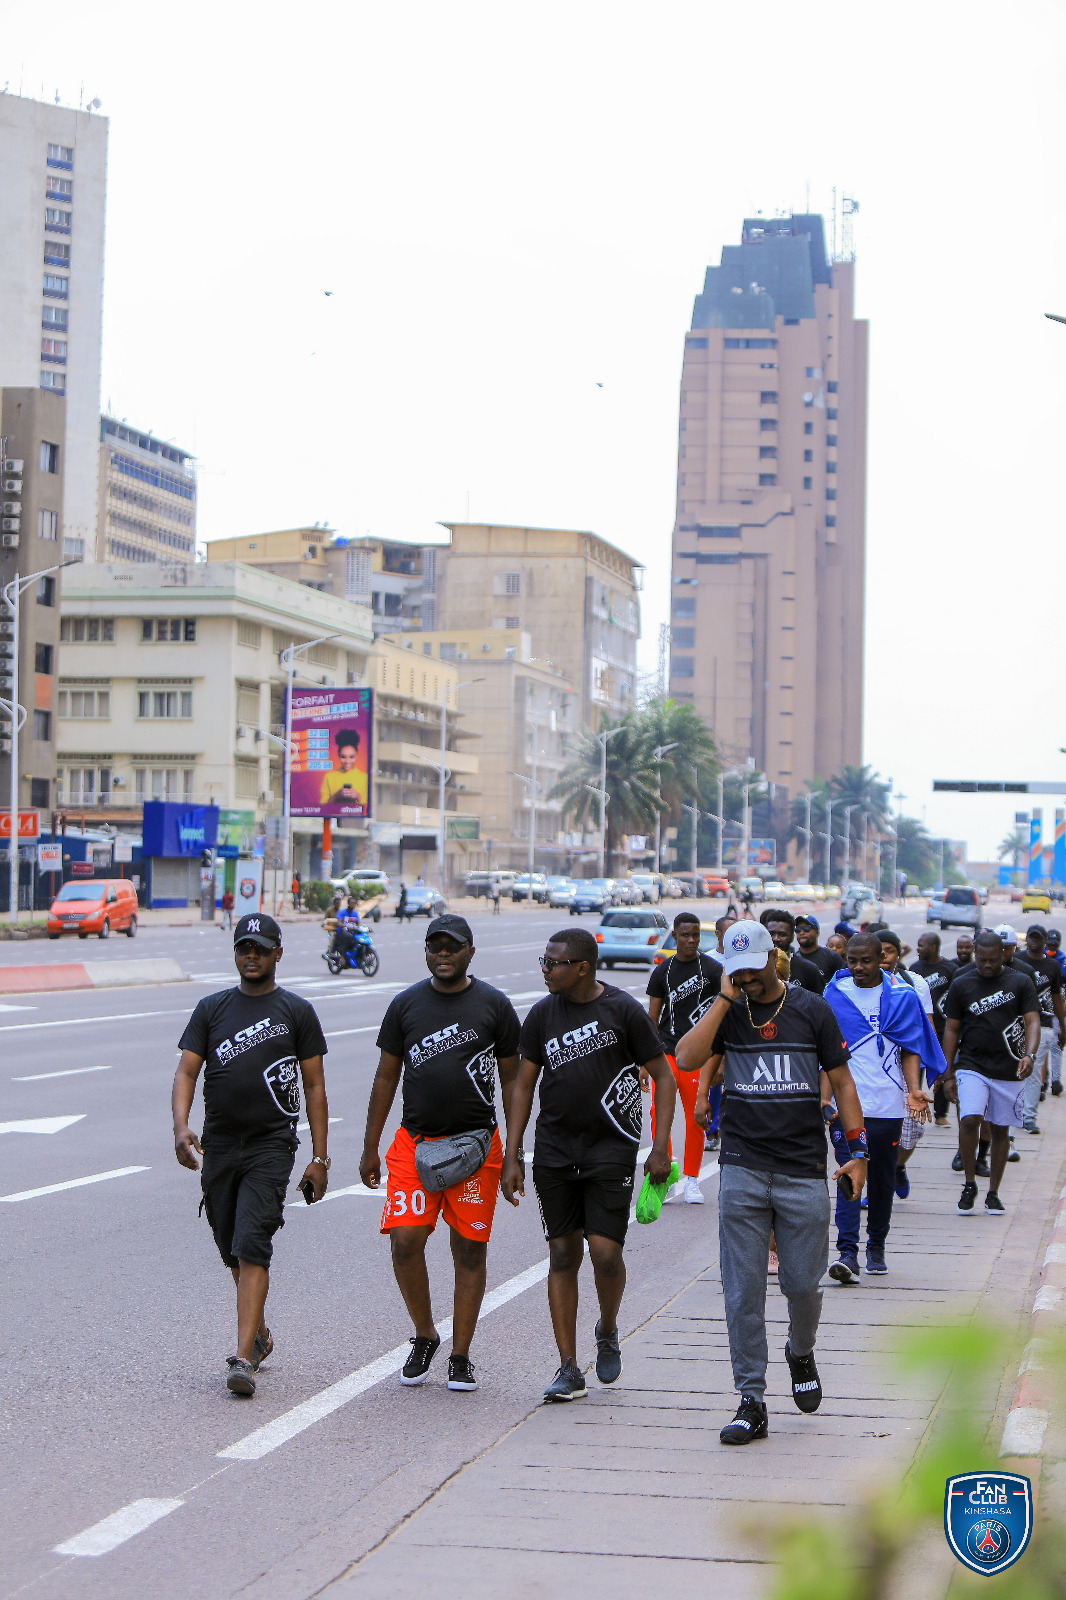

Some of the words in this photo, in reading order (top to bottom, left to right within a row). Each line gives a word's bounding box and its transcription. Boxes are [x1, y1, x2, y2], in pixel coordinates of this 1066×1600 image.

[330, 703, 358, 714] EXTRA
[319, 729, 329, 738] GB
[319, 739, 329, 748] GB
[319, 750, 328, 759] GB
[323, 761, 332, 769] GB
[219, 1023, 290, 1066] KINSHASA
[548, 1029, 618, 1070] KINSHASA
[760, 1083, 777, 1092] LIVE
[778, 1082, 810, 1091] LIMITLES
[392, 1189, 426, 1217] 30
[794, 1379, 819, 1393] PUMA
